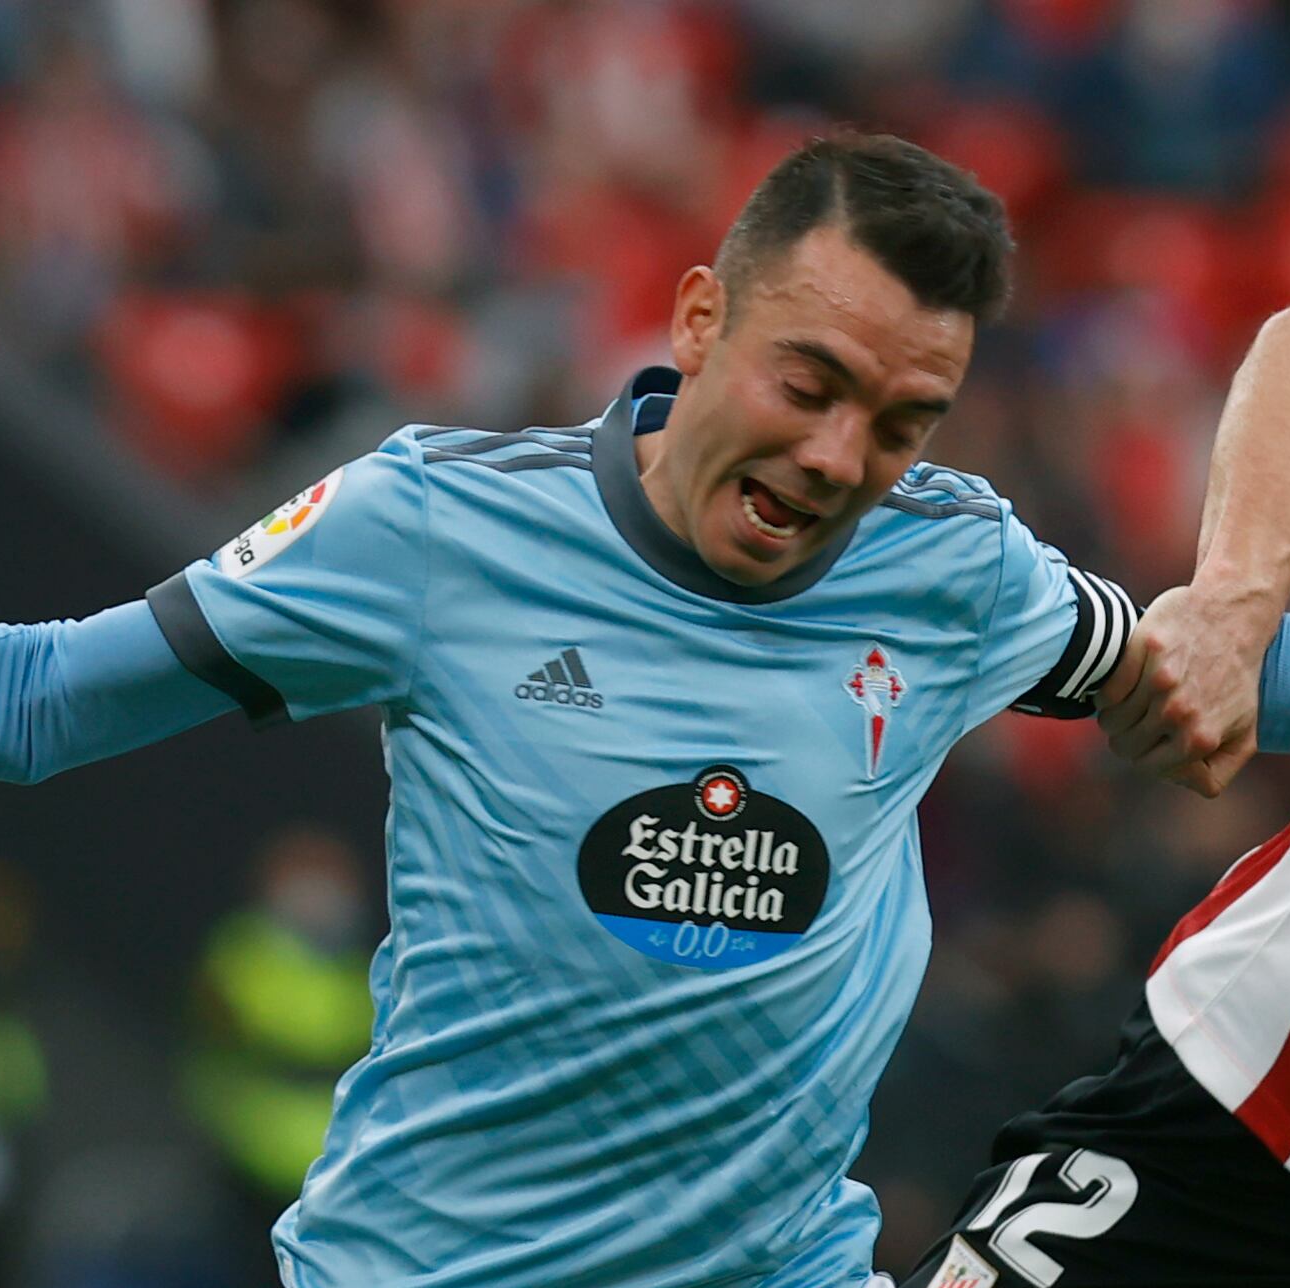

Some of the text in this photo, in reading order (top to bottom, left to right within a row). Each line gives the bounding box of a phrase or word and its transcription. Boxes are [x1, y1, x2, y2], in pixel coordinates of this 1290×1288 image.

[514, 682, 604, 709] adidas
[621, 814, 800, 876] Estrella
[624, 862, 785, 922] Galicia
